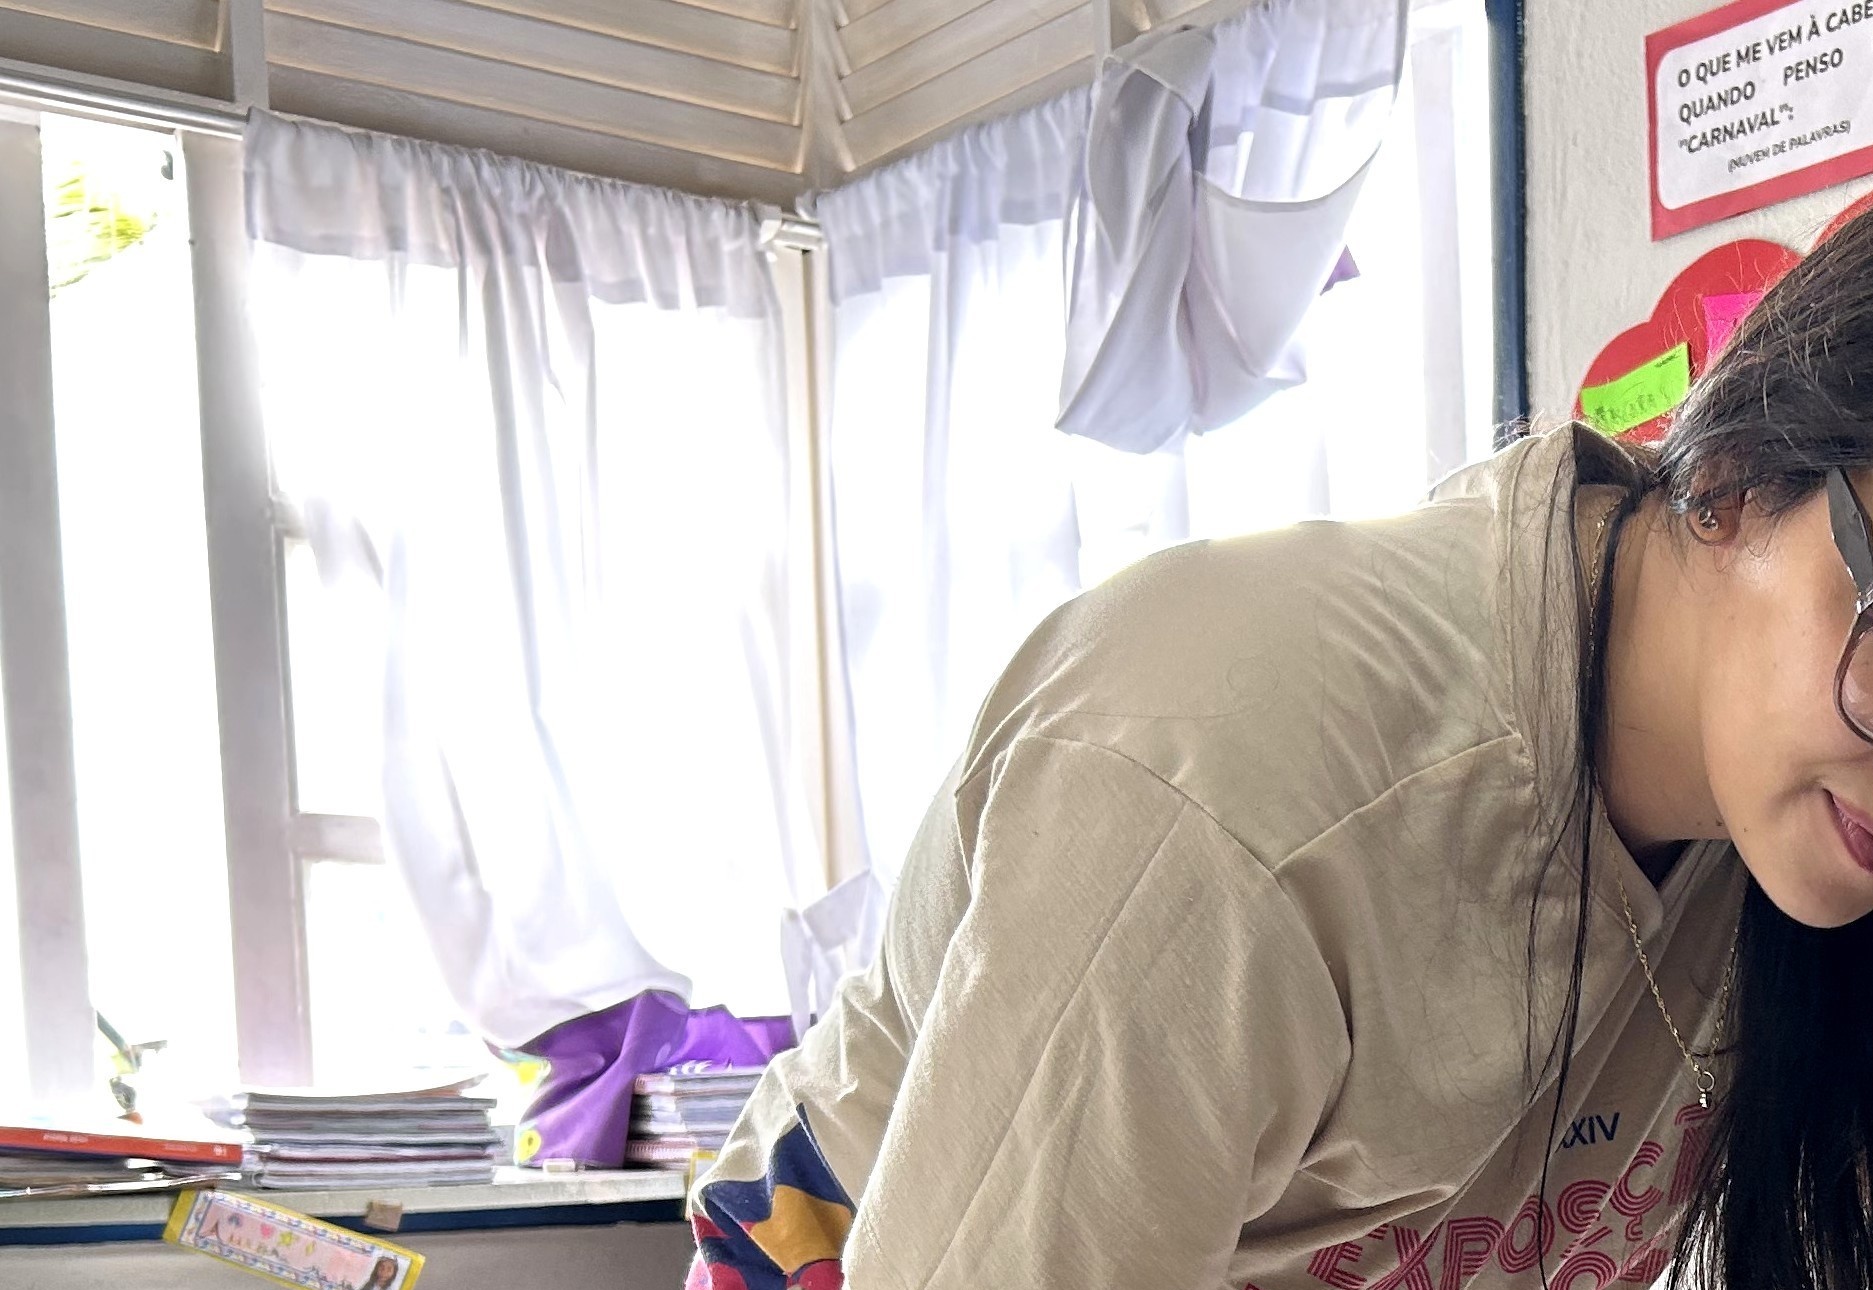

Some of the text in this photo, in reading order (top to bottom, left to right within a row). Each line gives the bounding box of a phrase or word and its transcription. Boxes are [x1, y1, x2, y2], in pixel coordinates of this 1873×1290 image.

[1677, 68, 1691, 88] O
[1695, 53, 1731, 84] QUE
[1736, 42, 1762, 67] ME
[1766, 25, 1802, 55] VEM
[1806, 14, 1821, 41] À
[1679, 80, 1756, 126] QUANDO
[1783, 48, 1844, 86] PENSO
[1771, 140, 1786, 156] DE
